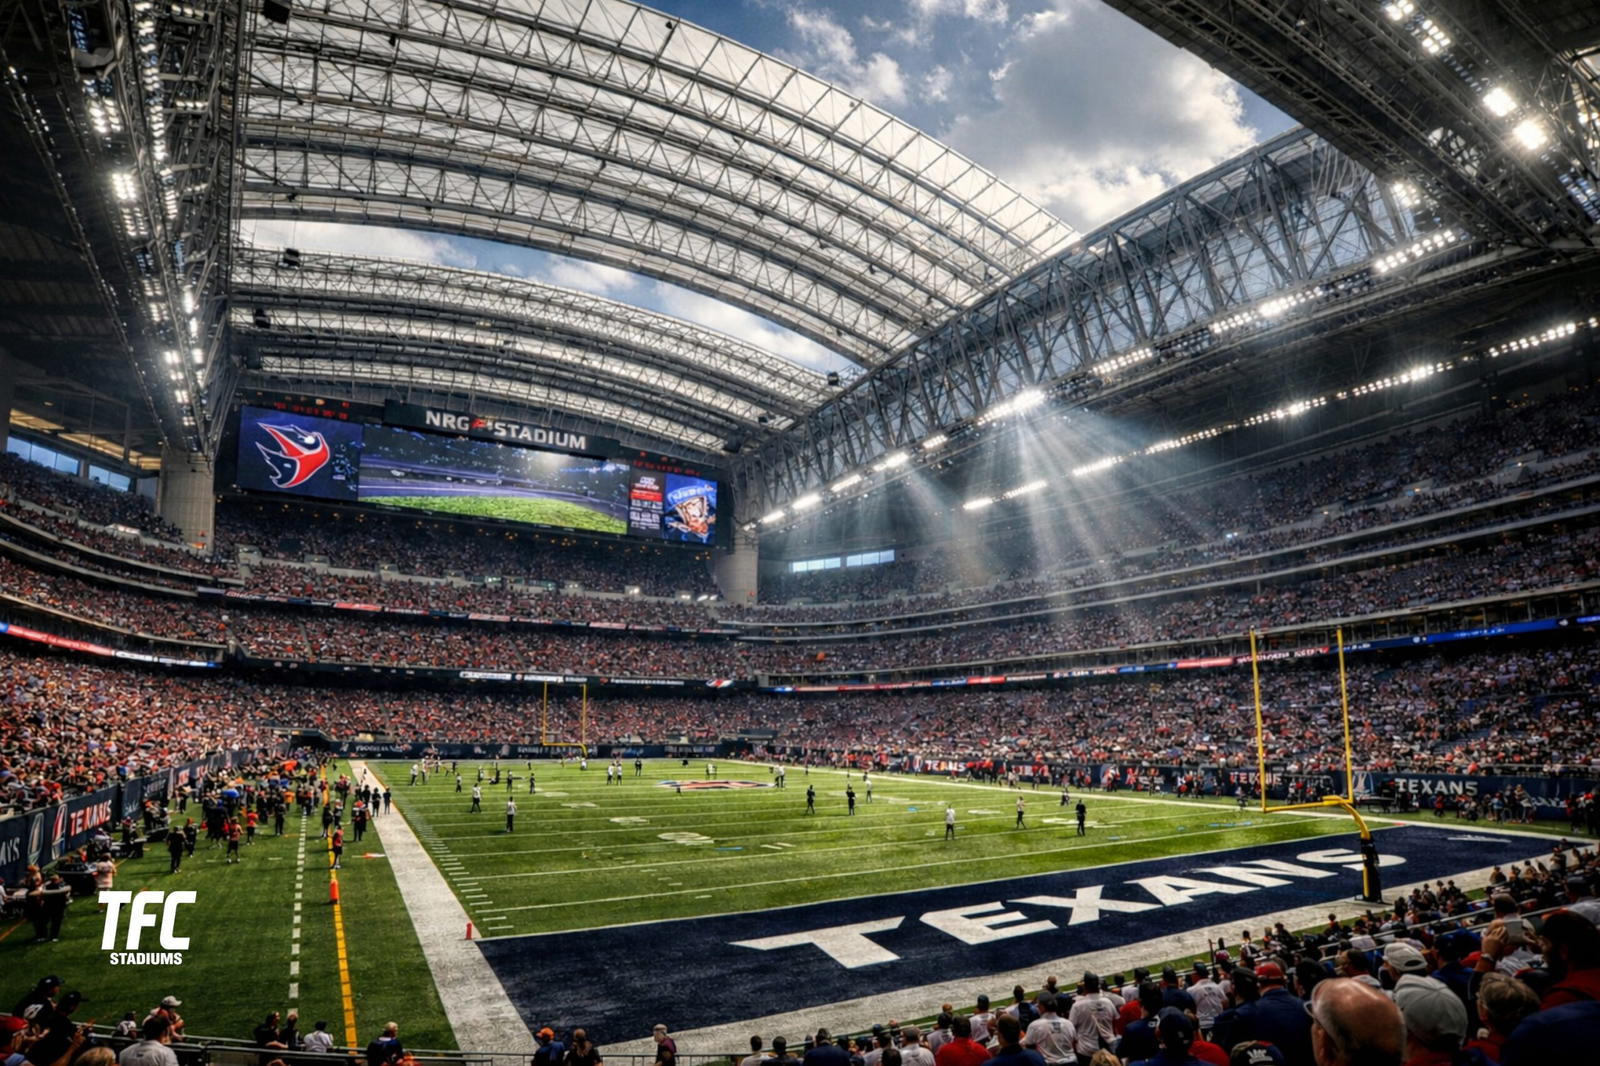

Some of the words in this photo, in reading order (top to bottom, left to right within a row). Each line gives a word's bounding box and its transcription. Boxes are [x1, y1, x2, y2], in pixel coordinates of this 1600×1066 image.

[425, 410, 471, 431] NRG
[494, 422, 587, 450] STADIUM
[1394, 777, 1479, 797] TEXANS
[70, 800, 112, 837] TEXANS
[728, 848, 1407, 969] TEXANS
